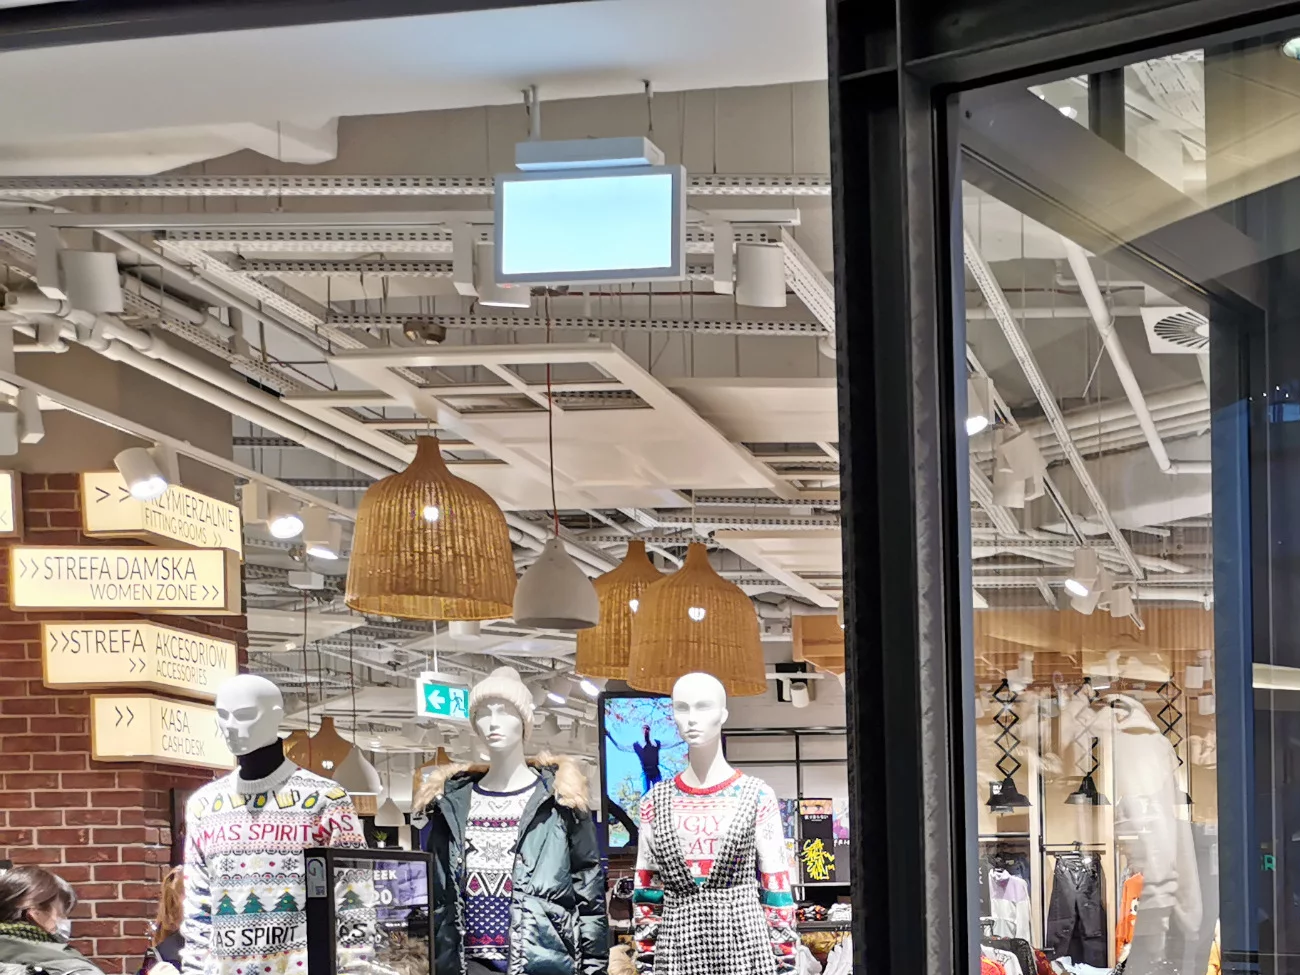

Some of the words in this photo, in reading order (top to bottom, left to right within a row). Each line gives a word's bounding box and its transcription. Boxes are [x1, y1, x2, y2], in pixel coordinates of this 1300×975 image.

[144, 488, 234, 532] RZYMIERZALNIE
[145, 507, 177, 534] FITTING
[178, 519, 207, 544] ROOMS
[44, 556, 112, 580] STREFA
[116, 557, 197, 580] DAMSKA
[90, 584, 152, 600] WOMEN
[156, 584, 197, 600] ZONE
[70, 630, 146, 654] STREFA
[156, 660, 208, 686] ACCESSORIES
[161, 706, 191, 734] KASA
[162, 734, 183, 753] CASH
[185, 738, 205, 756] DESK
[248, 823, 312, 841] SPIRIT
[213, 930, 236, 947] AS
[241, 925, 299, 947] SPIRIT
